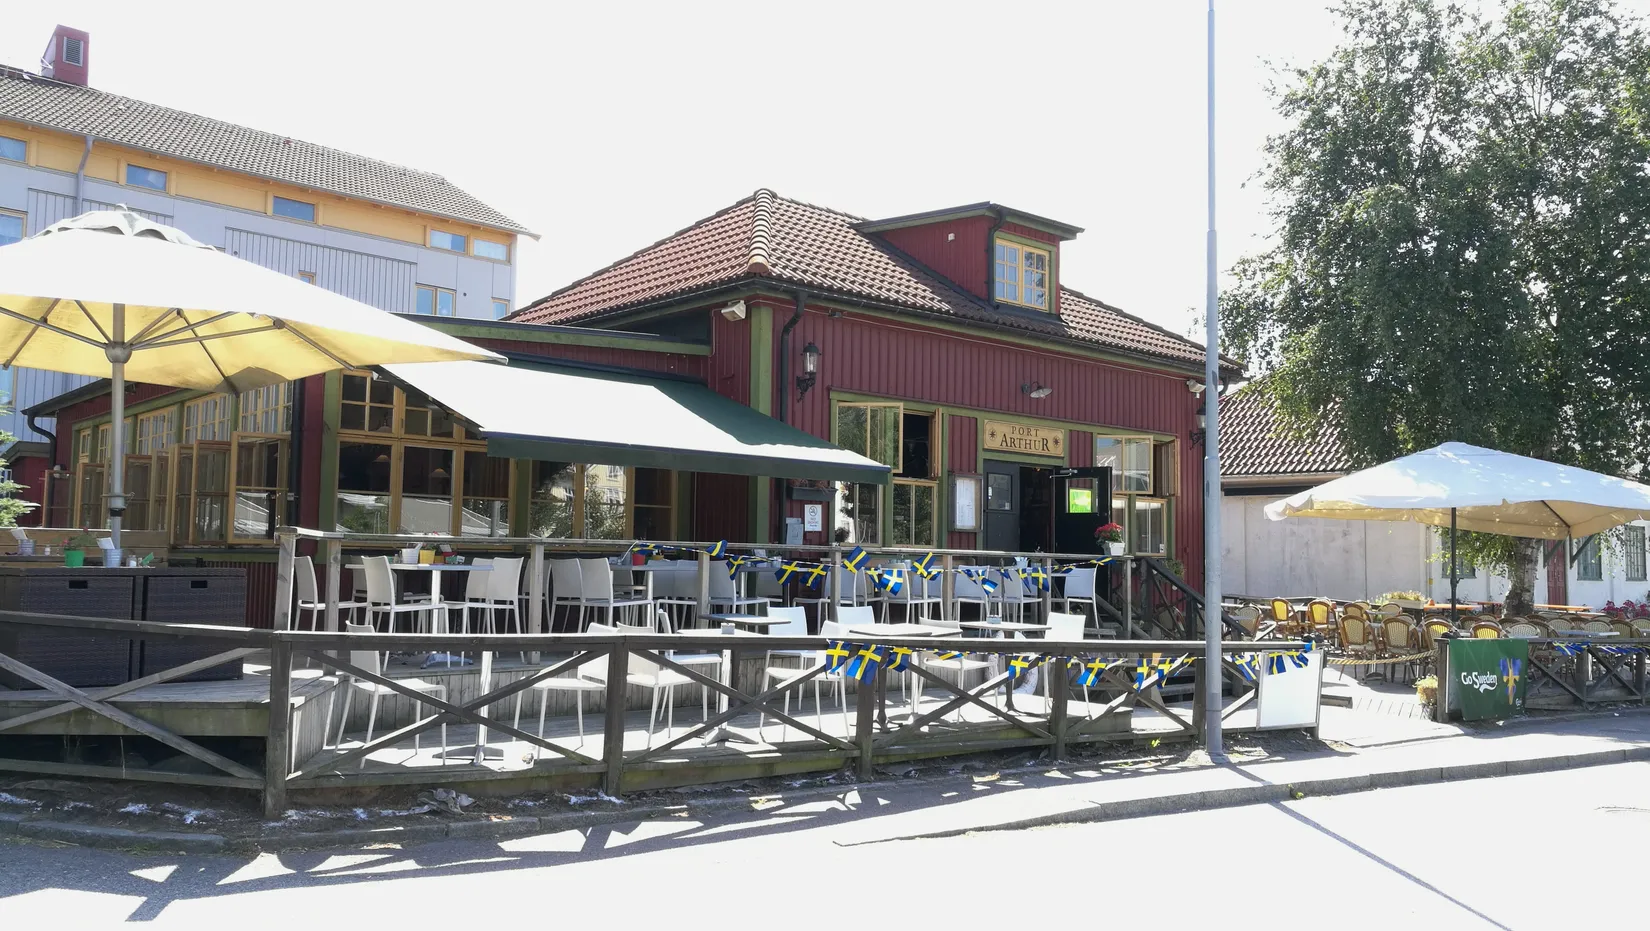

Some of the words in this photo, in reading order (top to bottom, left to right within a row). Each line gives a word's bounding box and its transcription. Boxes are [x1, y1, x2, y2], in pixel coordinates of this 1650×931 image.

[1011, 425, 1040, 437] PORT
[1000, 433, 1050, 452] ARTHUR
[1461, 671, 1473, 685] Go
[1472, 671, 1498, 692] Sweden
